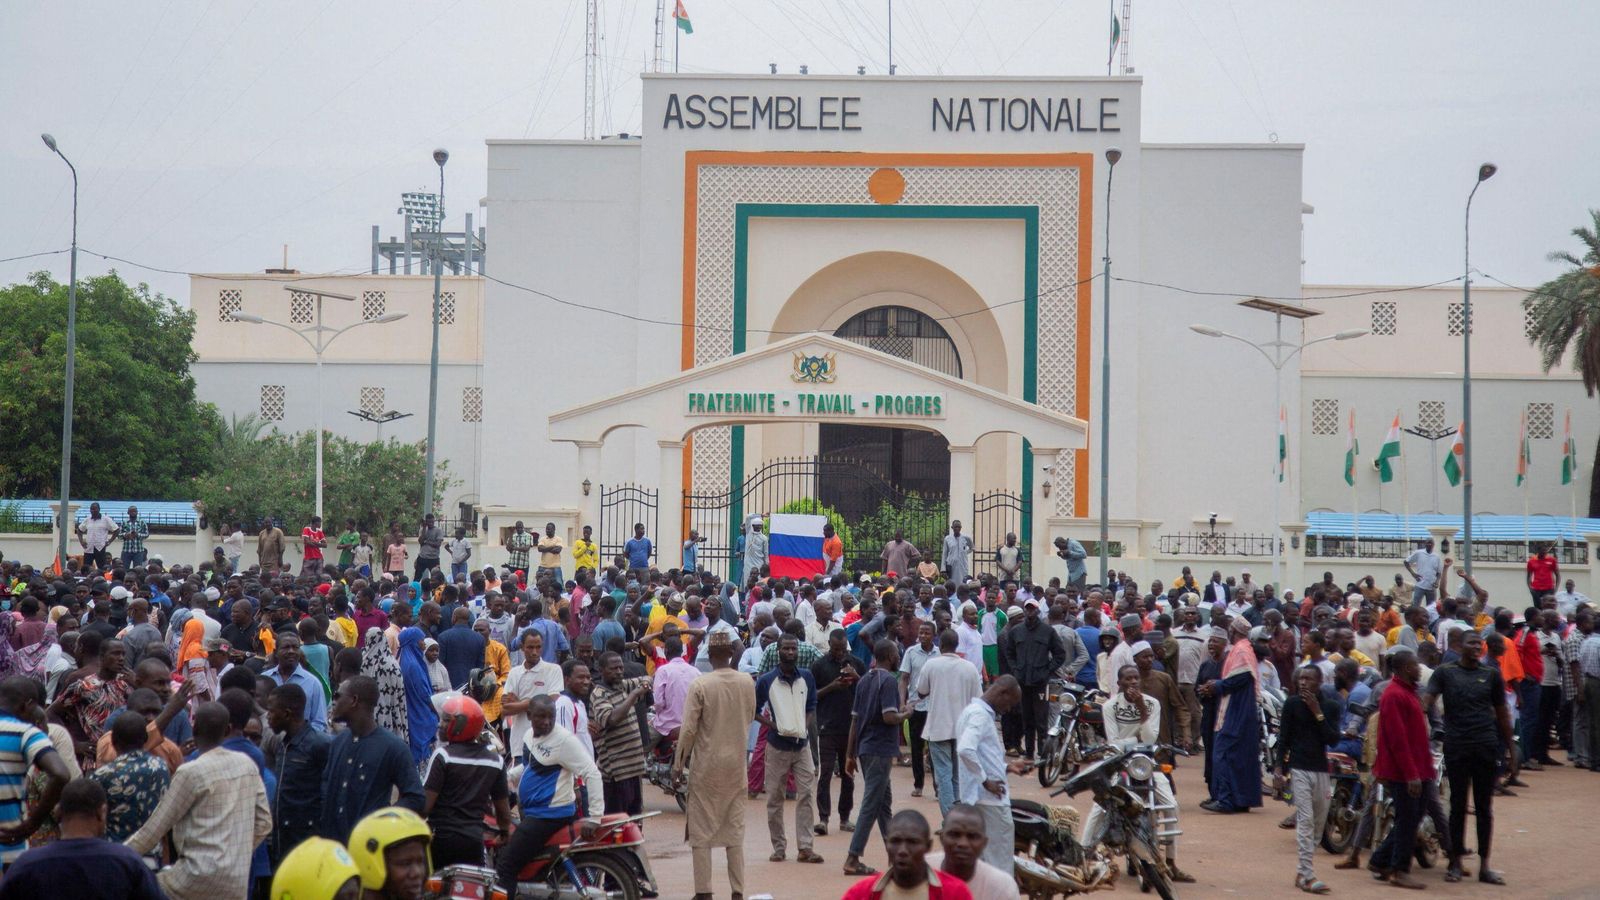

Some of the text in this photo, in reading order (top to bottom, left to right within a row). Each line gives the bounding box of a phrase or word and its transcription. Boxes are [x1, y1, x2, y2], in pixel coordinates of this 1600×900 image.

[663, 94, 1121, 132] ASSEMBLEE NATIONALE
[687, 392, 776, 413] FRATERNITE
[798, 393, 856, 414] TRAVAIL
[874, 394, 943, 415] PROGRES
